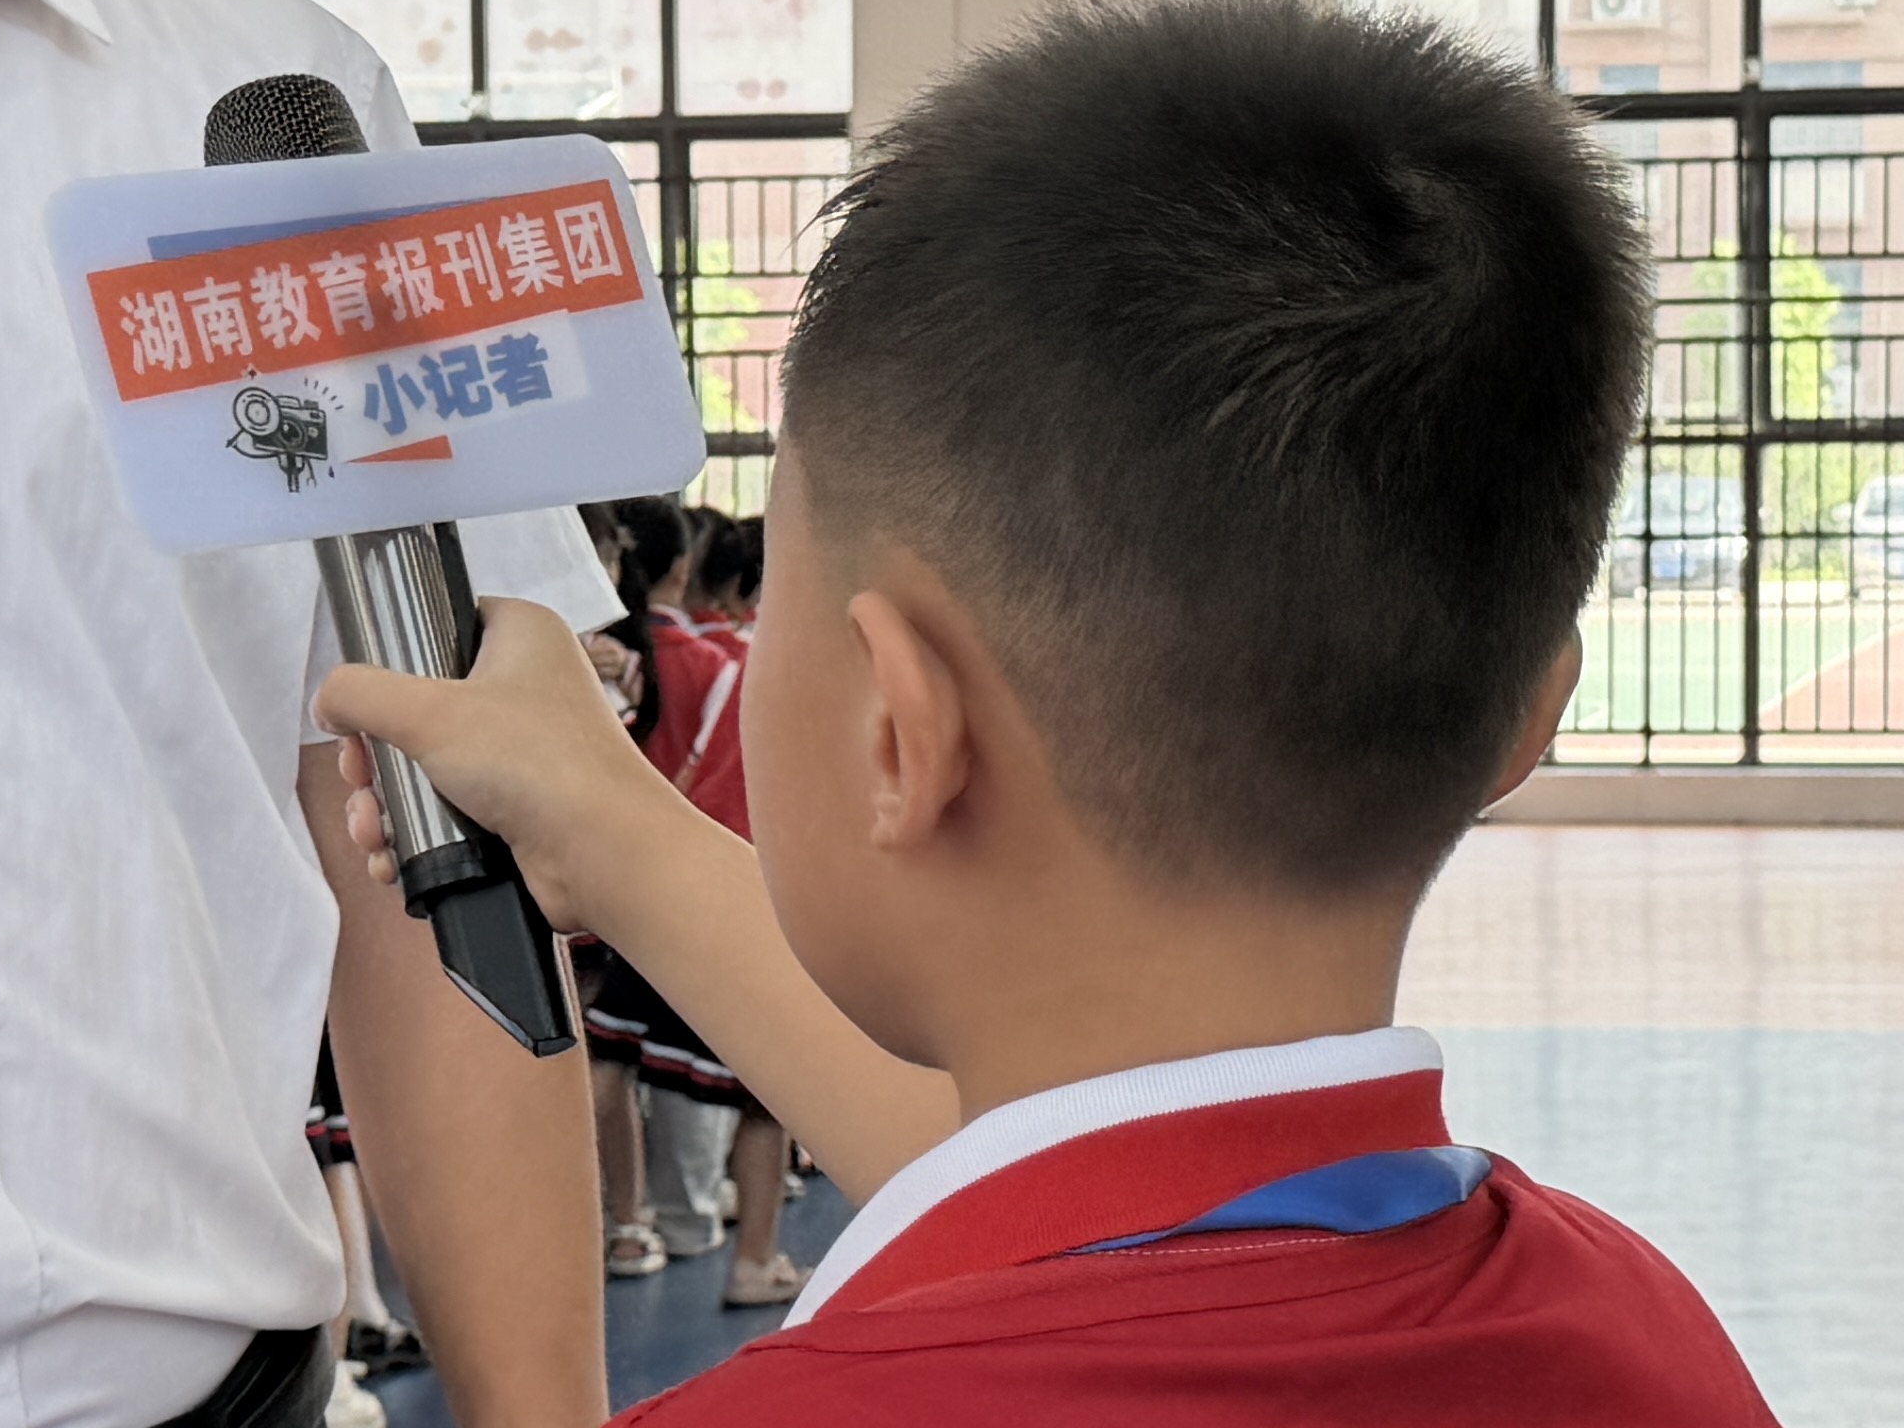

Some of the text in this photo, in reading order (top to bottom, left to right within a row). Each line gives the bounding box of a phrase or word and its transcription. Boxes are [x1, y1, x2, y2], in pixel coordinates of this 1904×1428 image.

[119, 201, 624, 376] 湖南教育报刊集团
[362, 332, 553, 436] 小记者
